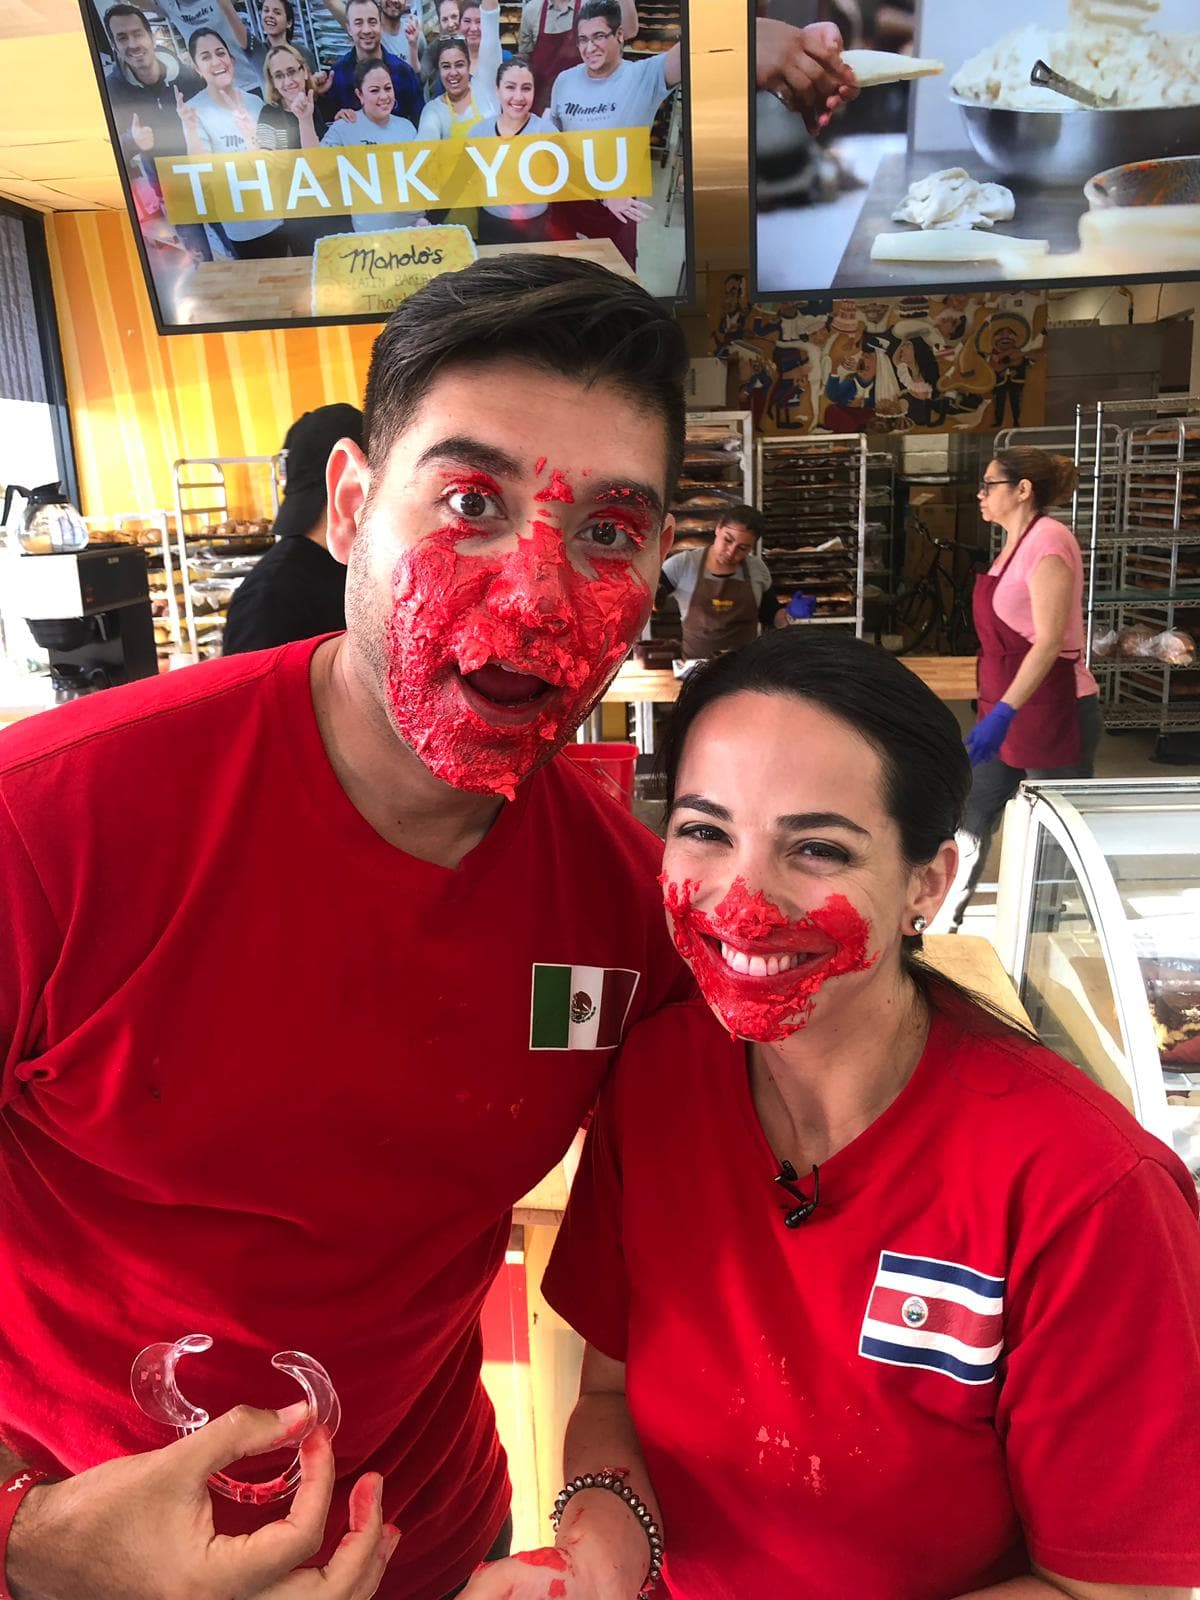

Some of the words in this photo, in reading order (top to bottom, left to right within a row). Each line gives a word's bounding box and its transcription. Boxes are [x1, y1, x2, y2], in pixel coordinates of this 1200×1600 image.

[172, 149, 439, 215] THANK
[466, 137, 628, 198] YOU
[340, 245, 445, 279] Manolo's
